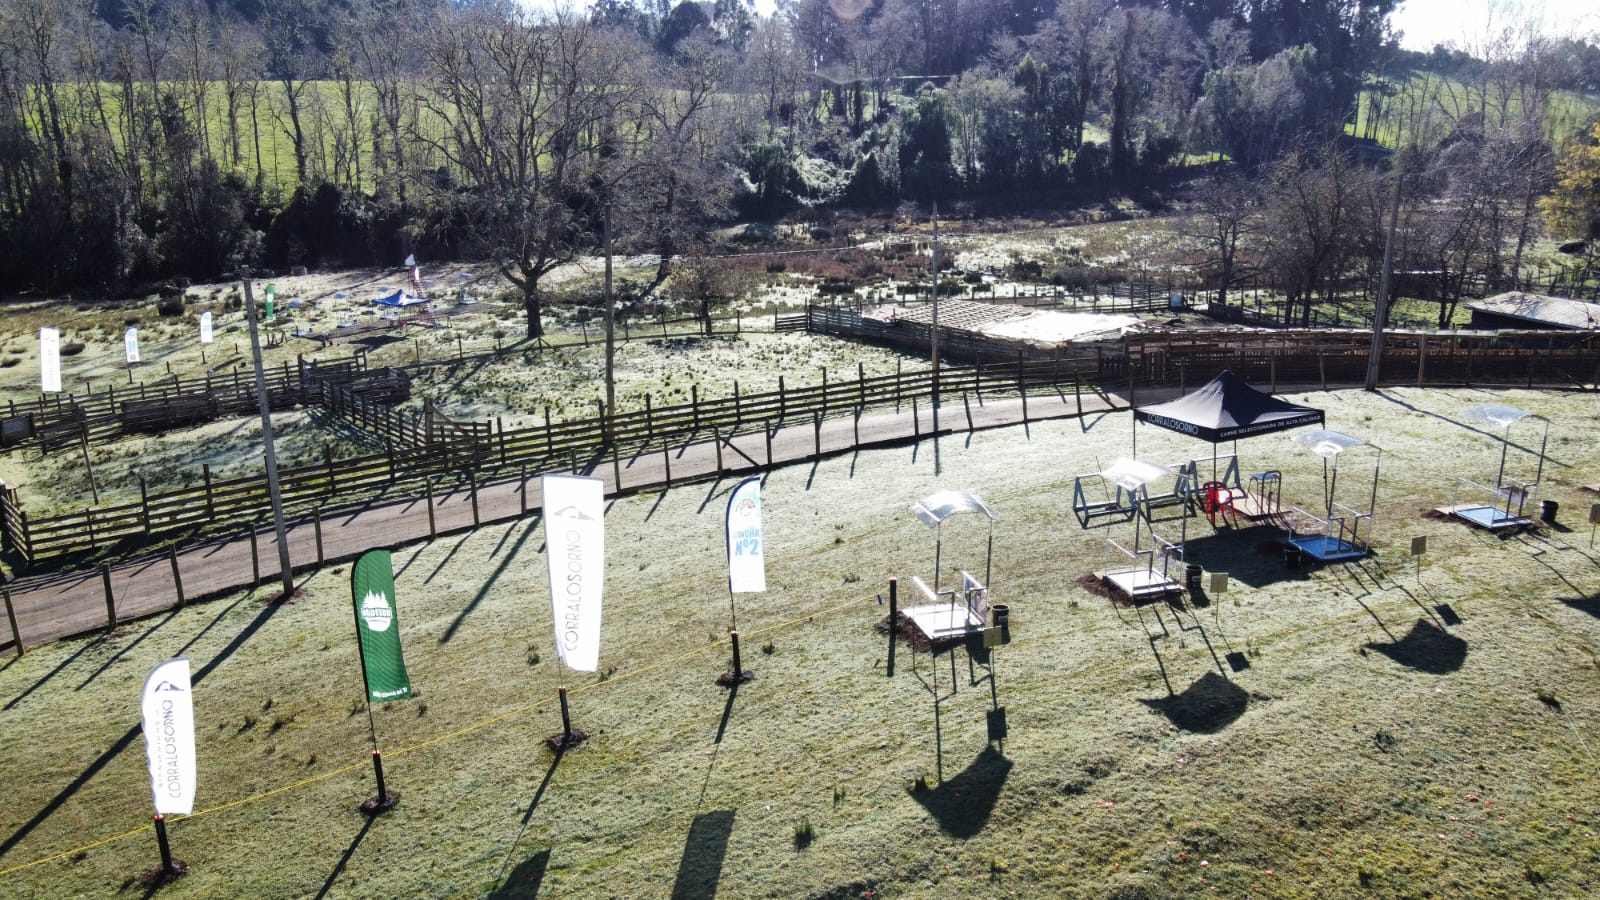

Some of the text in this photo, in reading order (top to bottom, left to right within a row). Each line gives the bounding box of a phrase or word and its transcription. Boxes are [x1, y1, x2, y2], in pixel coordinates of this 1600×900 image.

[1148, 413, 1199, 435] CORRALOSORNO
[564, 530, 583, 651] CORRALOSORNO
[162, 699, 181, 798] CORRALOSORNO
